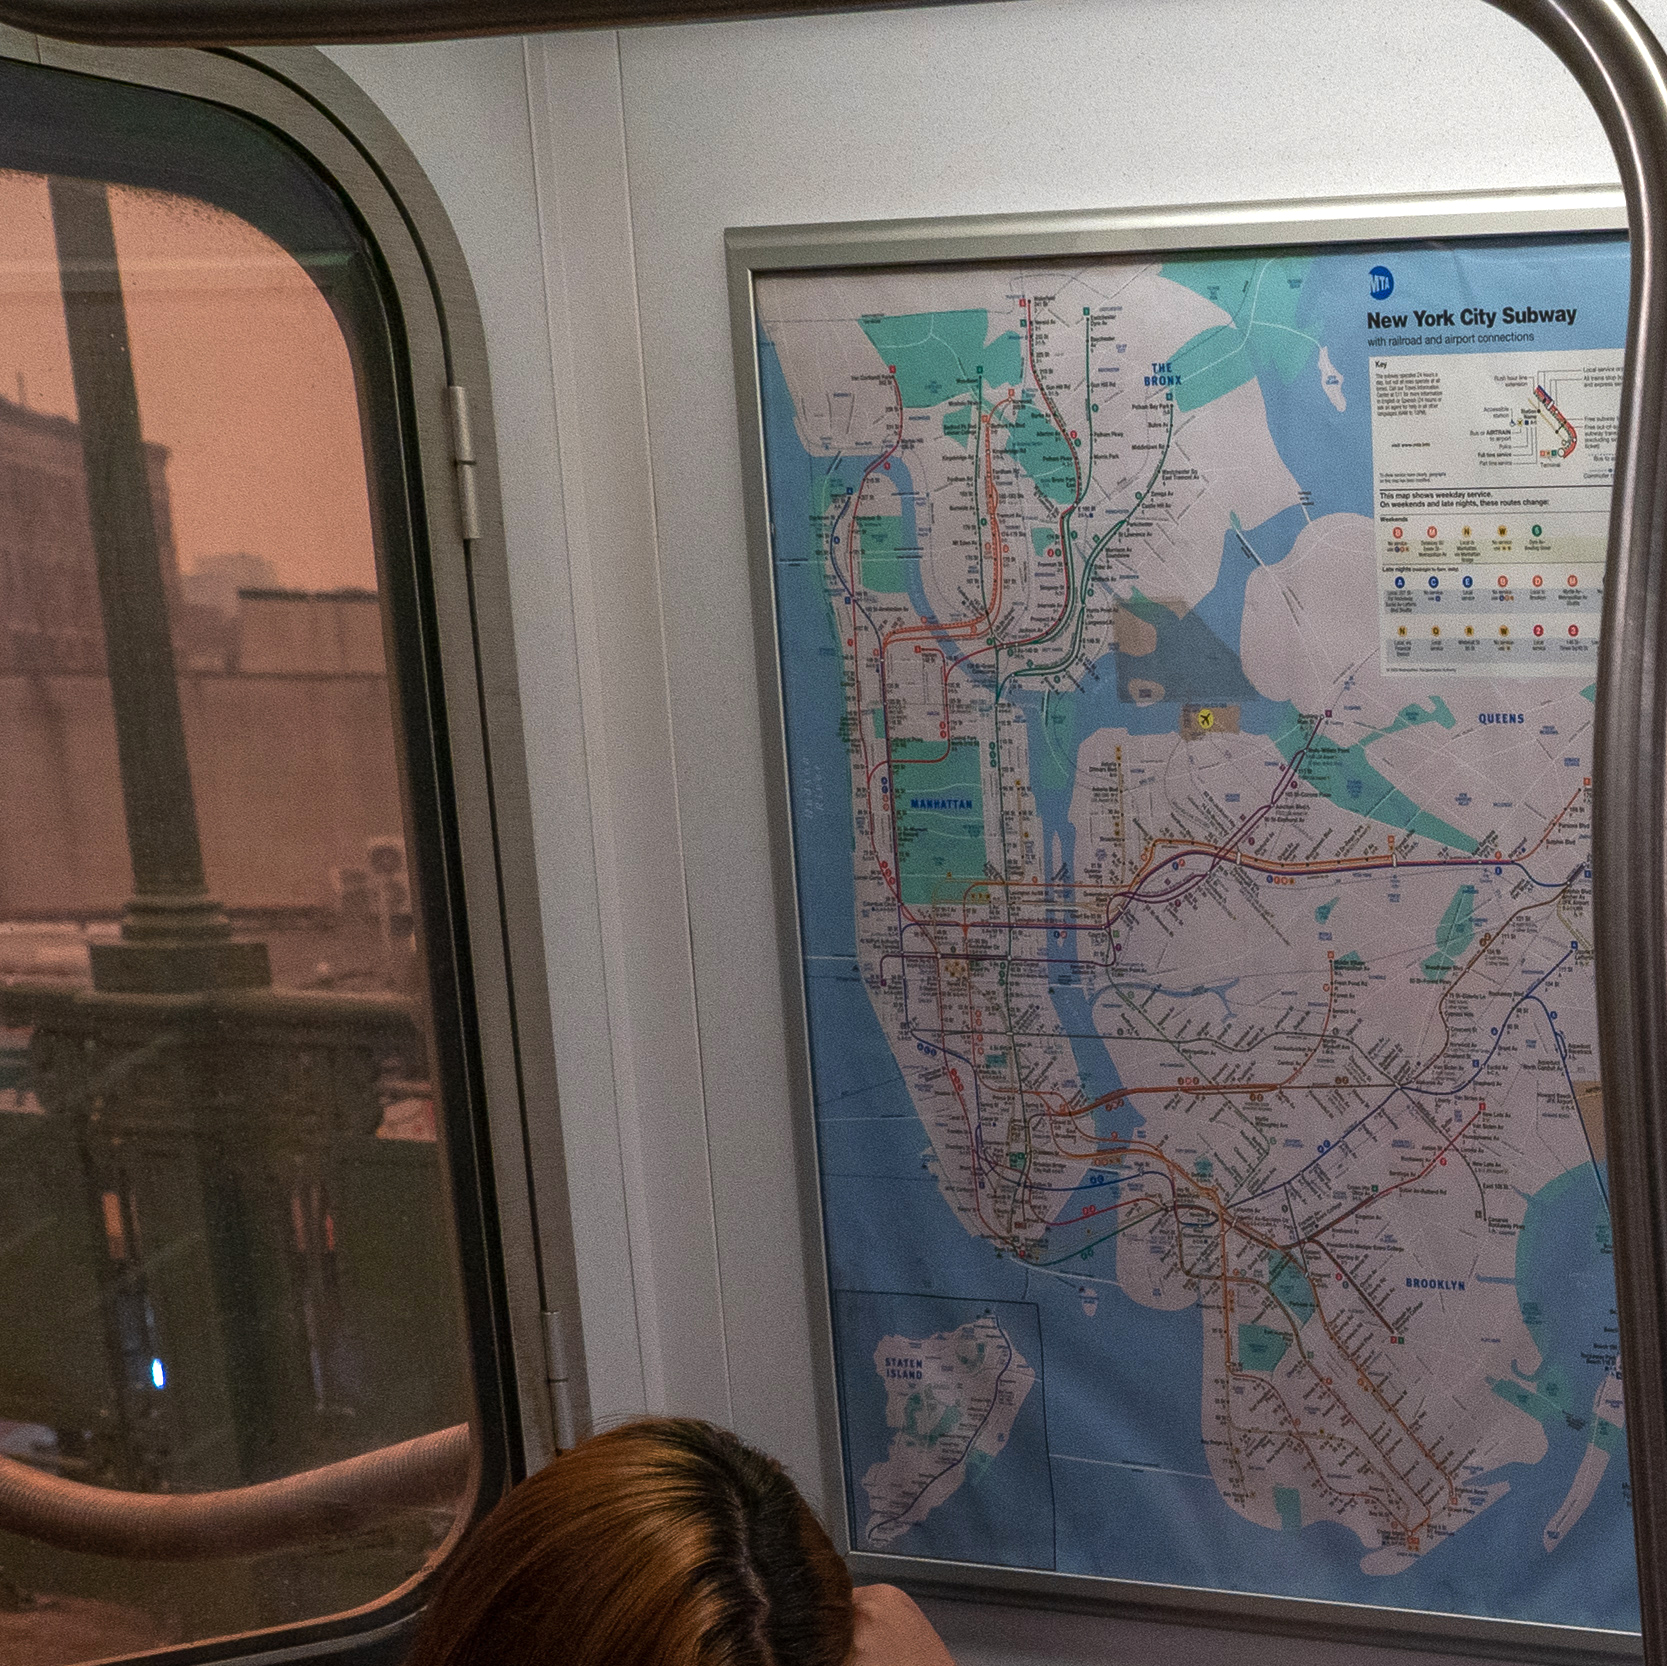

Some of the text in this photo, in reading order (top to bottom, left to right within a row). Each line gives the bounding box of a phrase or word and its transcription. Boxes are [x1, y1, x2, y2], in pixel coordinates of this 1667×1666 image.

[1367, 307, 1577, 329] New York City Subway
[1368, 332, 1534, 347] with railroad and airport connections
[1152, 363, 1172, 373] THE
[1375, 361, 1387, 369] Key
[1144, 376, 1181, 386] BRONX
[1434, 491, 1464, 500] weekday
[1391, 500, 1424, 508] weekends
[1456, 500, 1477, 508] nights,
[1479, 713, 1524, 724] QUEENS
[911, 799, 972, 809] MANHATTAN
[1406, 1278, 1465, 1290] BROOKLYN
[885, 1357, 922, 1368] STATEN
[886, 1369, 922, 1379] ISLAND
